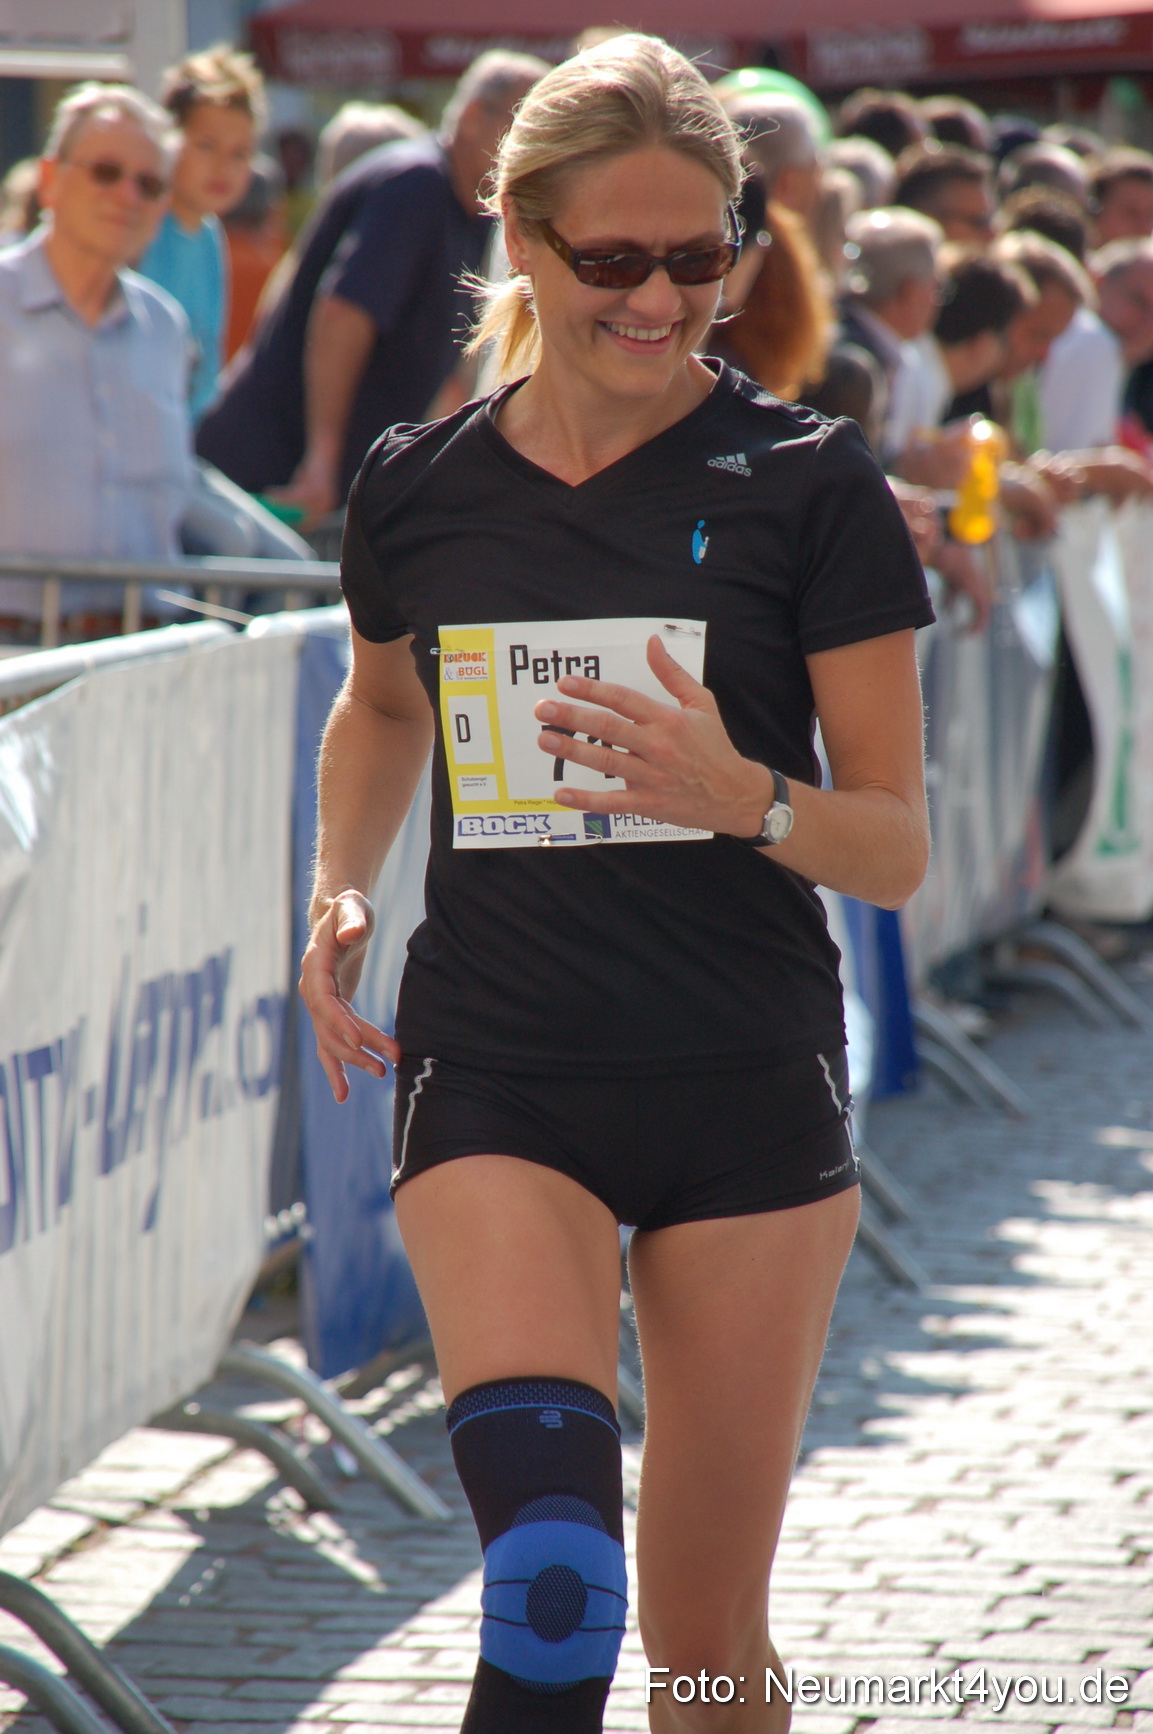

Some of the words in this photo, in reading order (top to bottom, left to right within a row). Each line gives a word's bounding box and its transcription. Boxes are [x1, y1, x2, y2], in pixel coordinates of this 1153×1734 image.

[707, 457, 752, 477] adidas
[509, 644, 600, 685] Petra
[455, 713, 471, 743] D
[457, 814, 552, 837] BOCK
